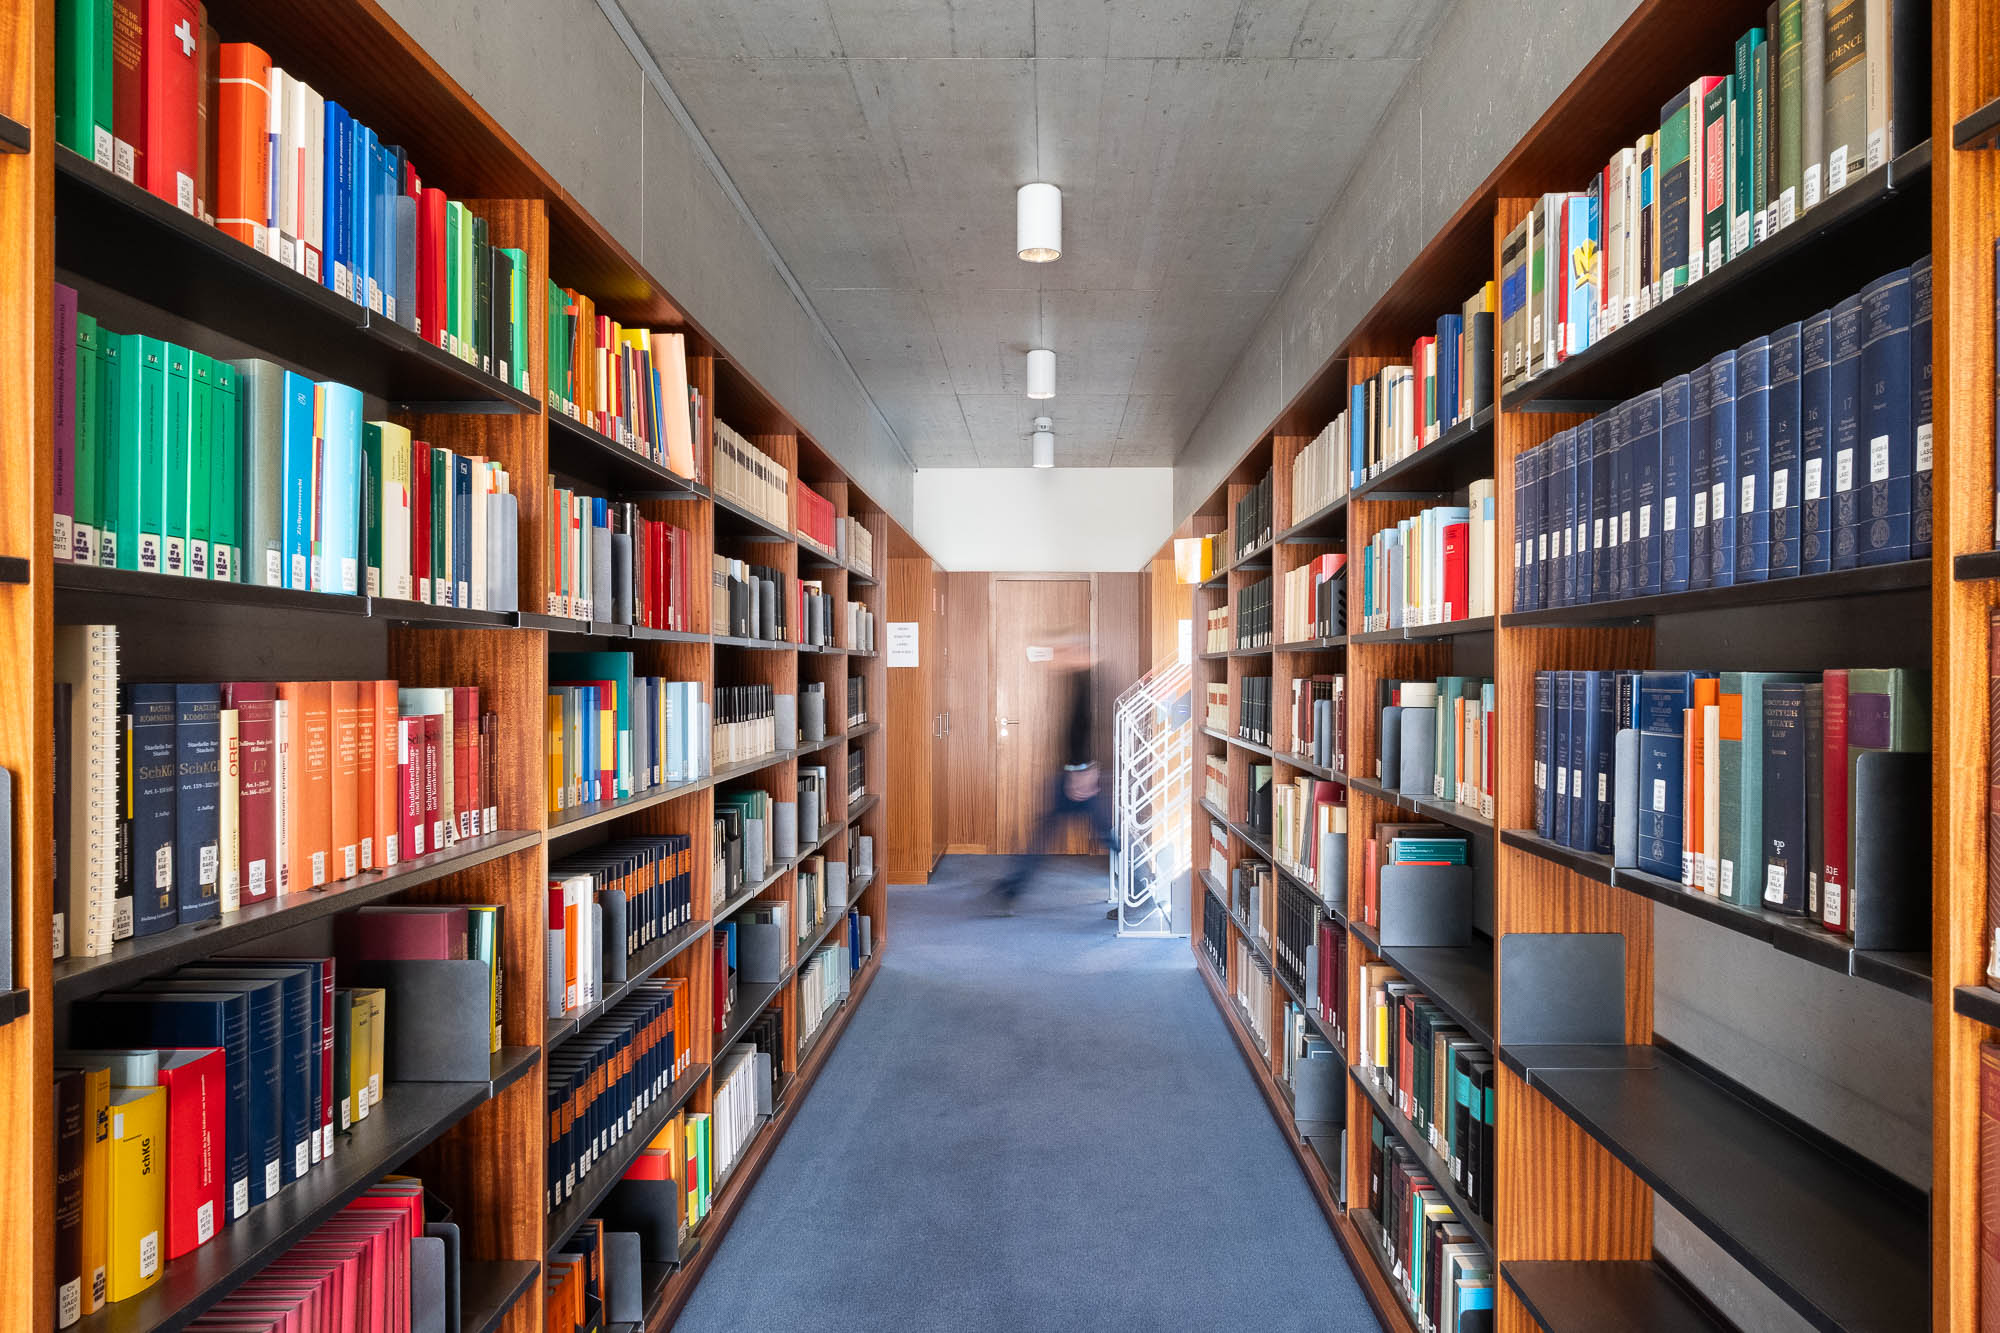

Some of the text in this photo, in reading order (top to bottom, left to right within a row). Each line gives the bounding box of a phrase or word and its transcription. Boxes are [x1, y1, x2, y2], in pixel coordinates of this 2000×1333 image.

[1808, 408, 1818, 421] 16
[229, 736, 238, 777] ORFI
[142, 1137, 150, 1176] SchKG
